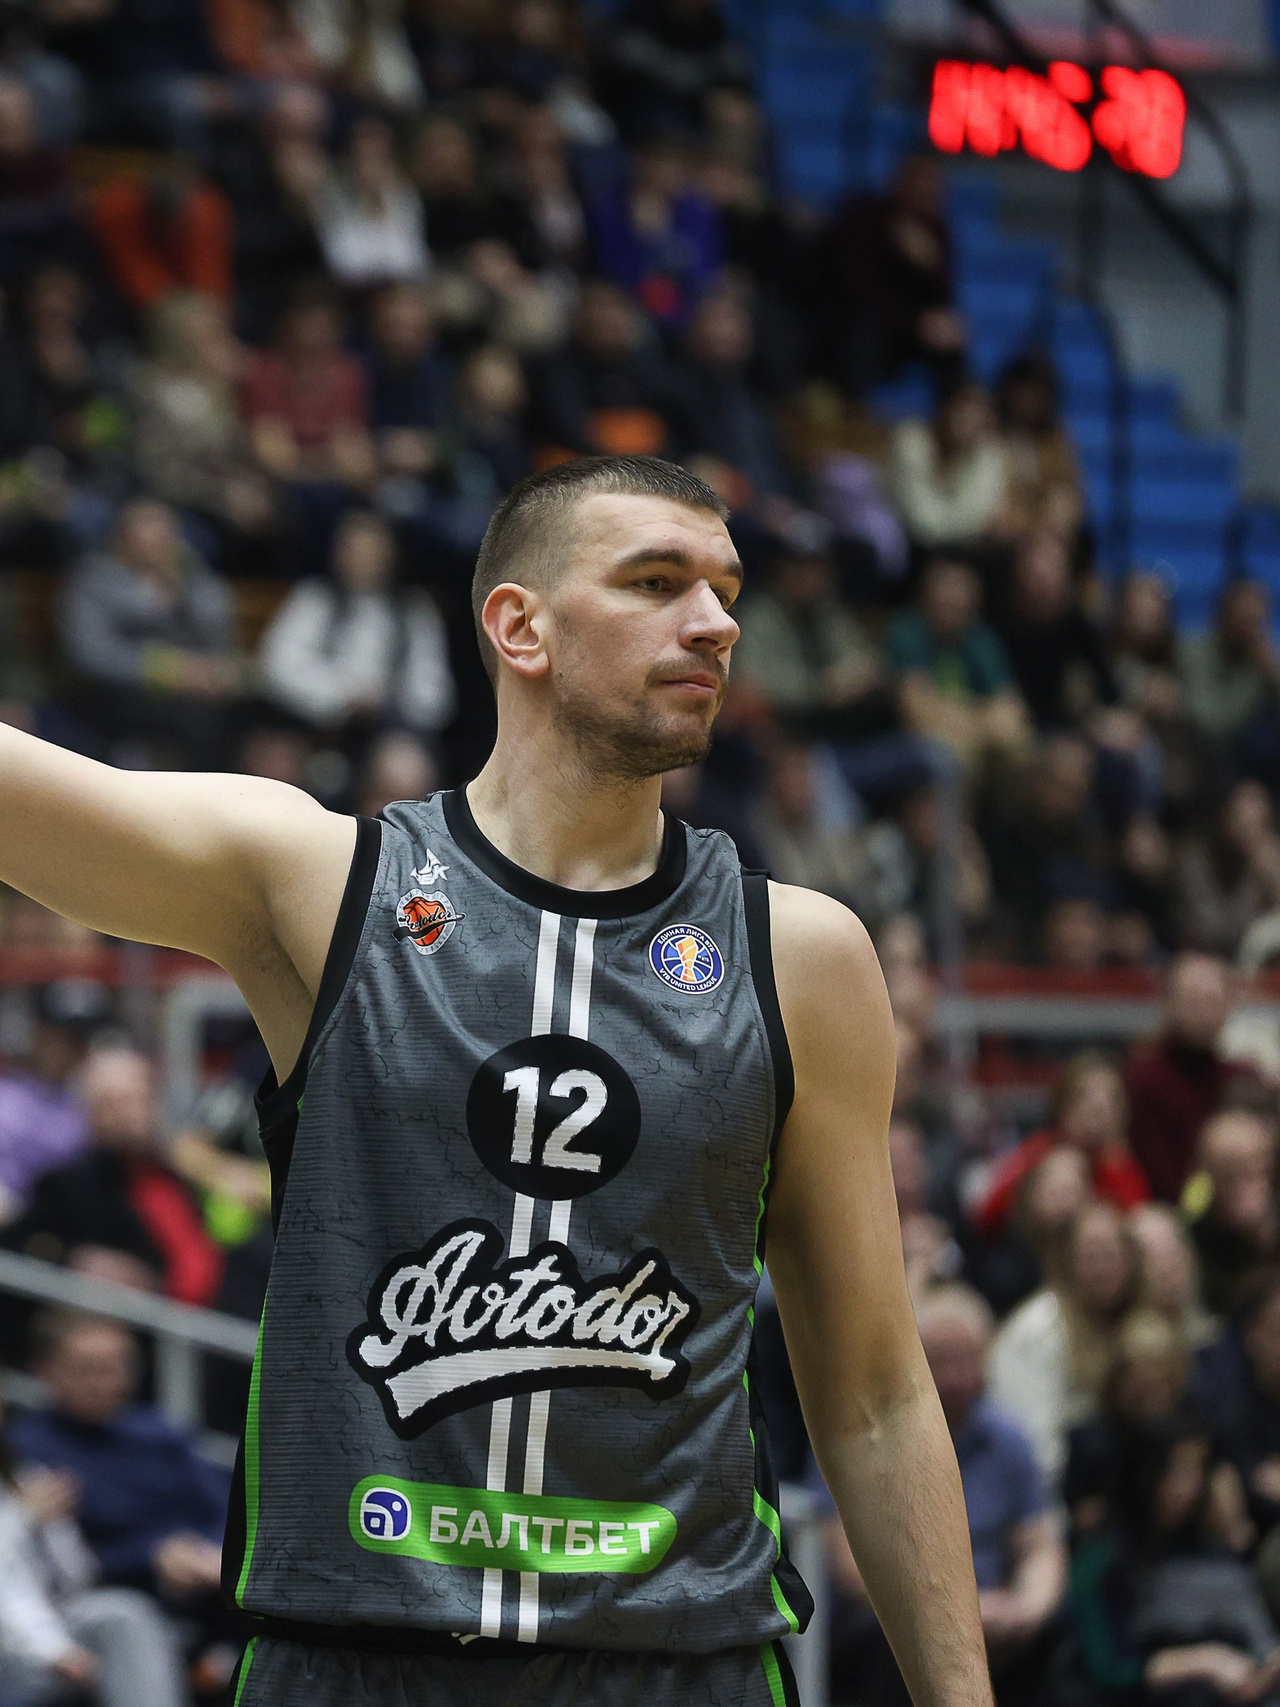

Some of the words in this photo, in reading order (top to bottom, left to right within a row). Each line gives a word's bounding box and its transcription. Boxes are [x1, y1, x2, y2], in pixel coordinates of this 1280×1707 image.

[657, 928, 685, 945] ЕДИНАЯ
[686, 928, 704, 941] ЛИГА
[659, 967, 671, 981] VTB
[671, 979, 695, 991] UNITED
[696, 975, 718, 991] LEAGUE
[502, 1066, 609, 1174] 12
[359, 1230, 690, 1381] Avtodor
[429, 1505, 660, 1555] БАЛТБЕТ
